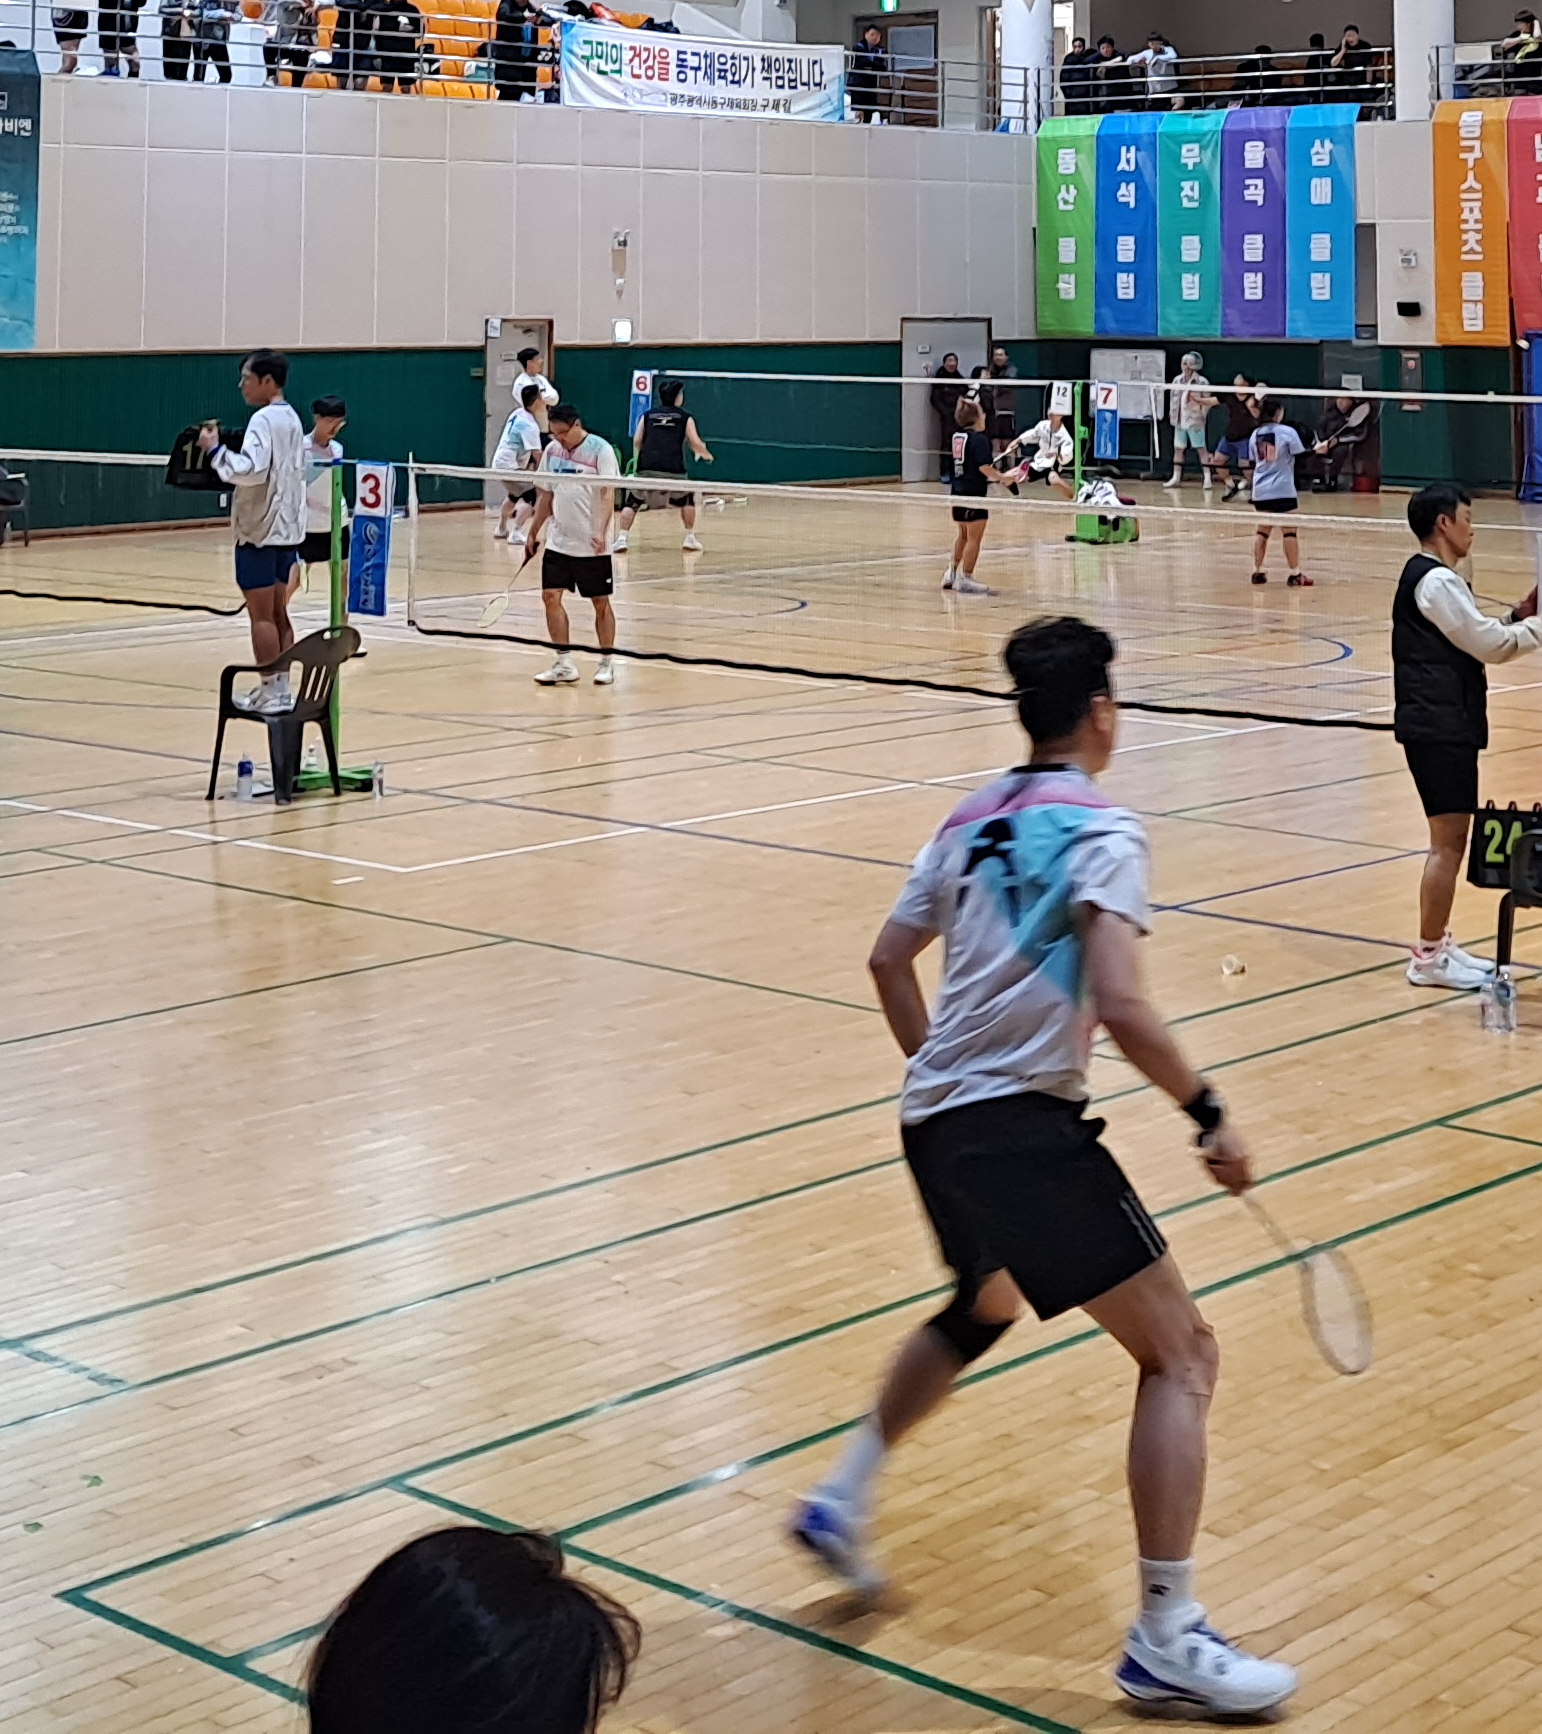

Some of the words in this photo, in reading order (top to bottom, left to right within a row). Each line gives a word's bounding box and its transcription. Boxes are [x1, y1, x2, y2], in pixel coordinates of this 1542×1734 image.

[580, 39, 623, 78] 구민의
[628, 44, 670, 82] 건강을
[676, 50, 756, 88] 동구체육회가
[1117, 145, 1136, 209] 서석
[1180, 143, 1201, 209] 무진
[1459, 111, 1484, 260] 동구스포츠
[1057, 386, 1067, 397] 12
[1100, 387, 1113, 405] 7
[360, 473, 381, 509] 3
